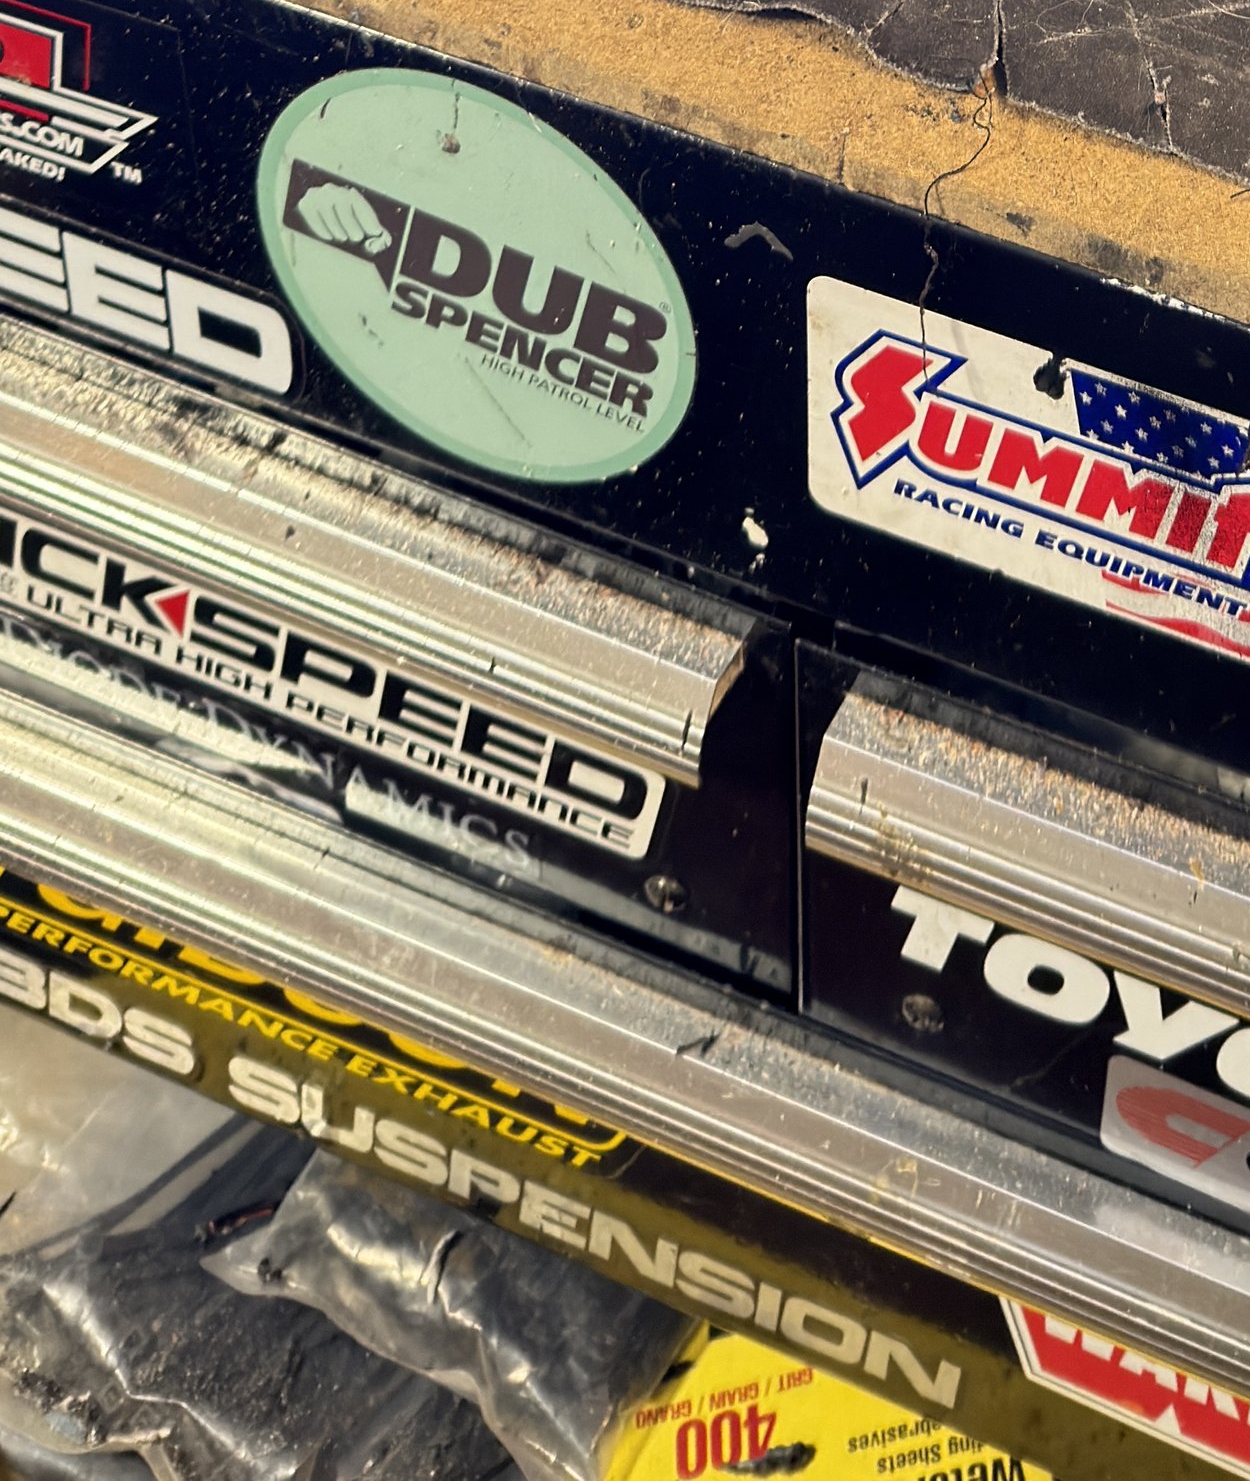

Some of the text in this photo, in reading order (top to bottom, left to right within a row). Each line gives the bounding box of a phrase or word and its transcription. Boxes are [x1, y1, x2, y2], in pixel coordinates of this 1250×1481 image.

[402, 206, 668, 375] DUB
[391, 281, 655, 419] SPENCER
[480, 353, 645, 435] HIGH PATROL LEVEL
[893, 478, 1250, 619] RACING EQUIPMENT
[27, 584, 638, 848] ULTRA HIGH PERFORMANCE
[345, 1054, 602, 1168] EXHAUST
[228, 1055, 962, 1411] SUSPENSION
[635, 1399, 692, 1429] GRANO
[709, 1382, 759, 1410] GRAIN
[777, 1367, 814, 1393] GRIT
[676, 1404, 777, 1481] 400
[876, 1443, 942, 1475] Sheets
